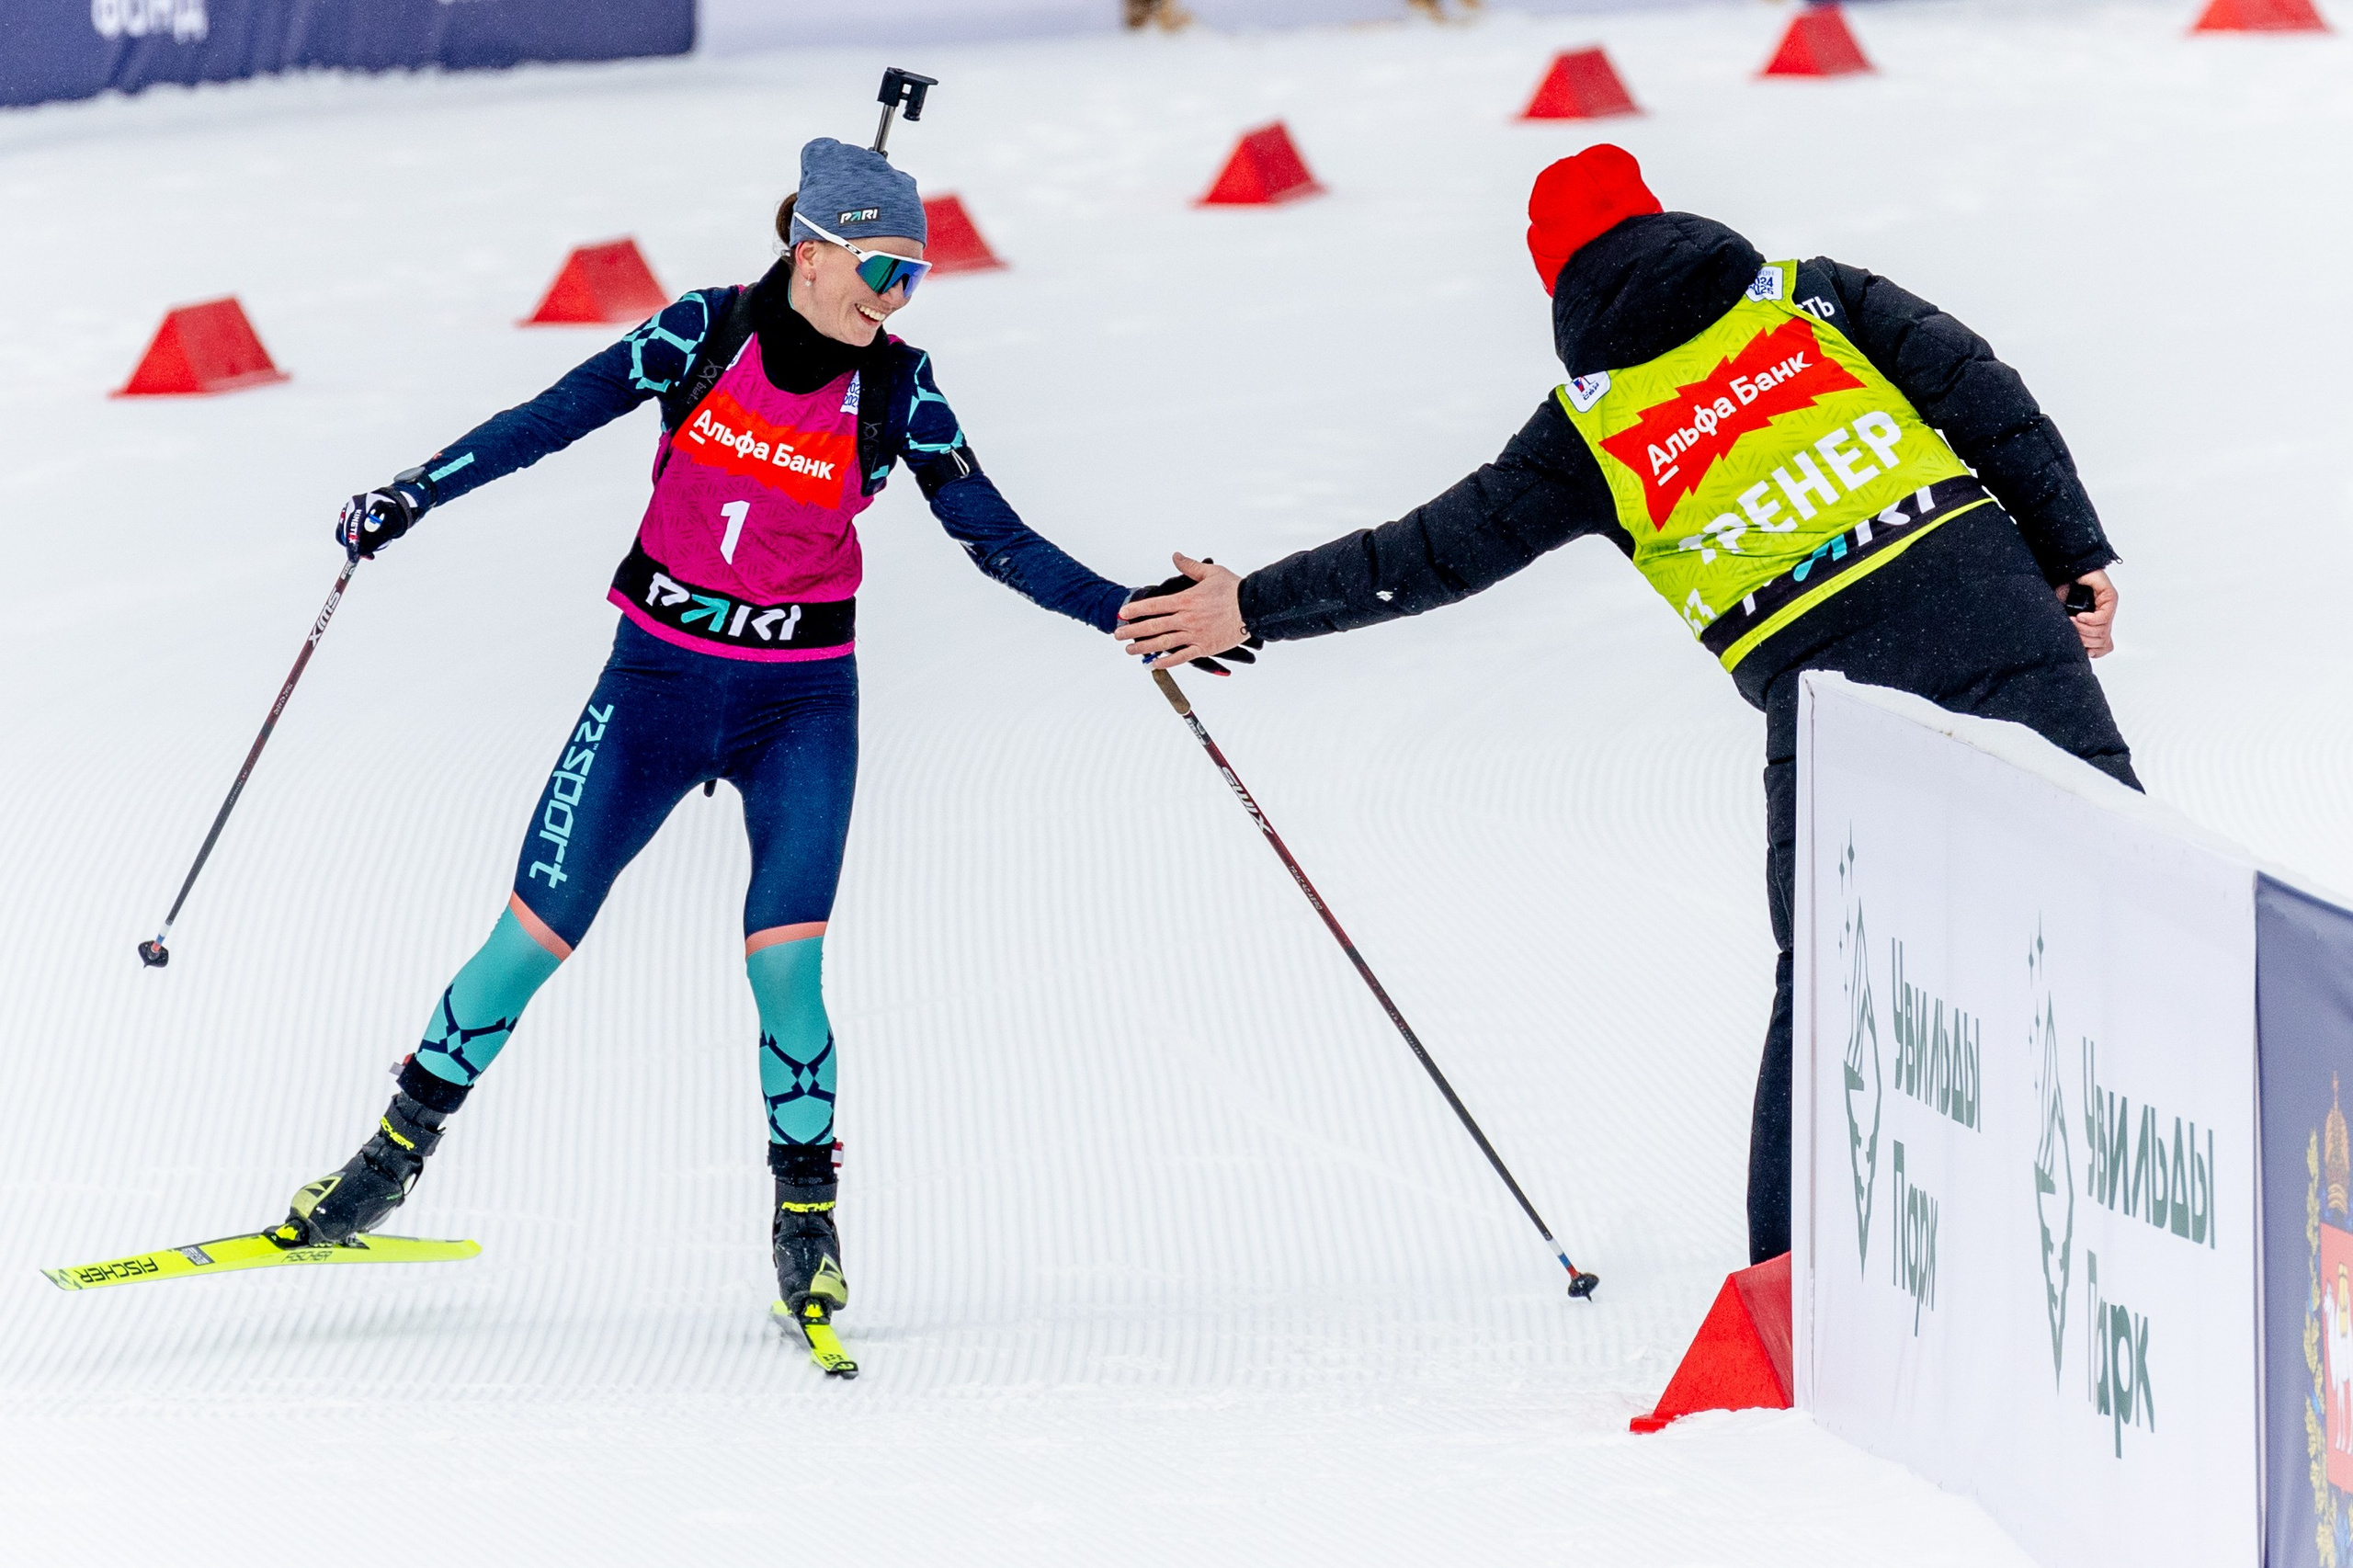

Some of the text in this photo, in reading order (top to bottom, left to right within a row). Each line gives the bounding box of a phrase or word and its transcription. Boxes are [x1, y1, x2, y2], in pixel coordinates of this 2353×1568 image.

[839, 209, 879, 224] PARI
[690, 409, 769, 461] Альфа
[772, 441, 835, 481] Банк
[1646, 350, 1813, 480] Альфа Банк
[720, 499, 751, 565] 1
[645, 572, 803, 642] PARI
[529, 703, 615, 889] 72sport
[1892, 937, 1982, 1134] Увильды
[2083, 1036, 2215, 1250] Увильды
[78, 1256, 158, 1284] FISCHER
[1893, 1139, 1938, 1338] Парк
[2087, 1248, 2155, 1460] Парк
